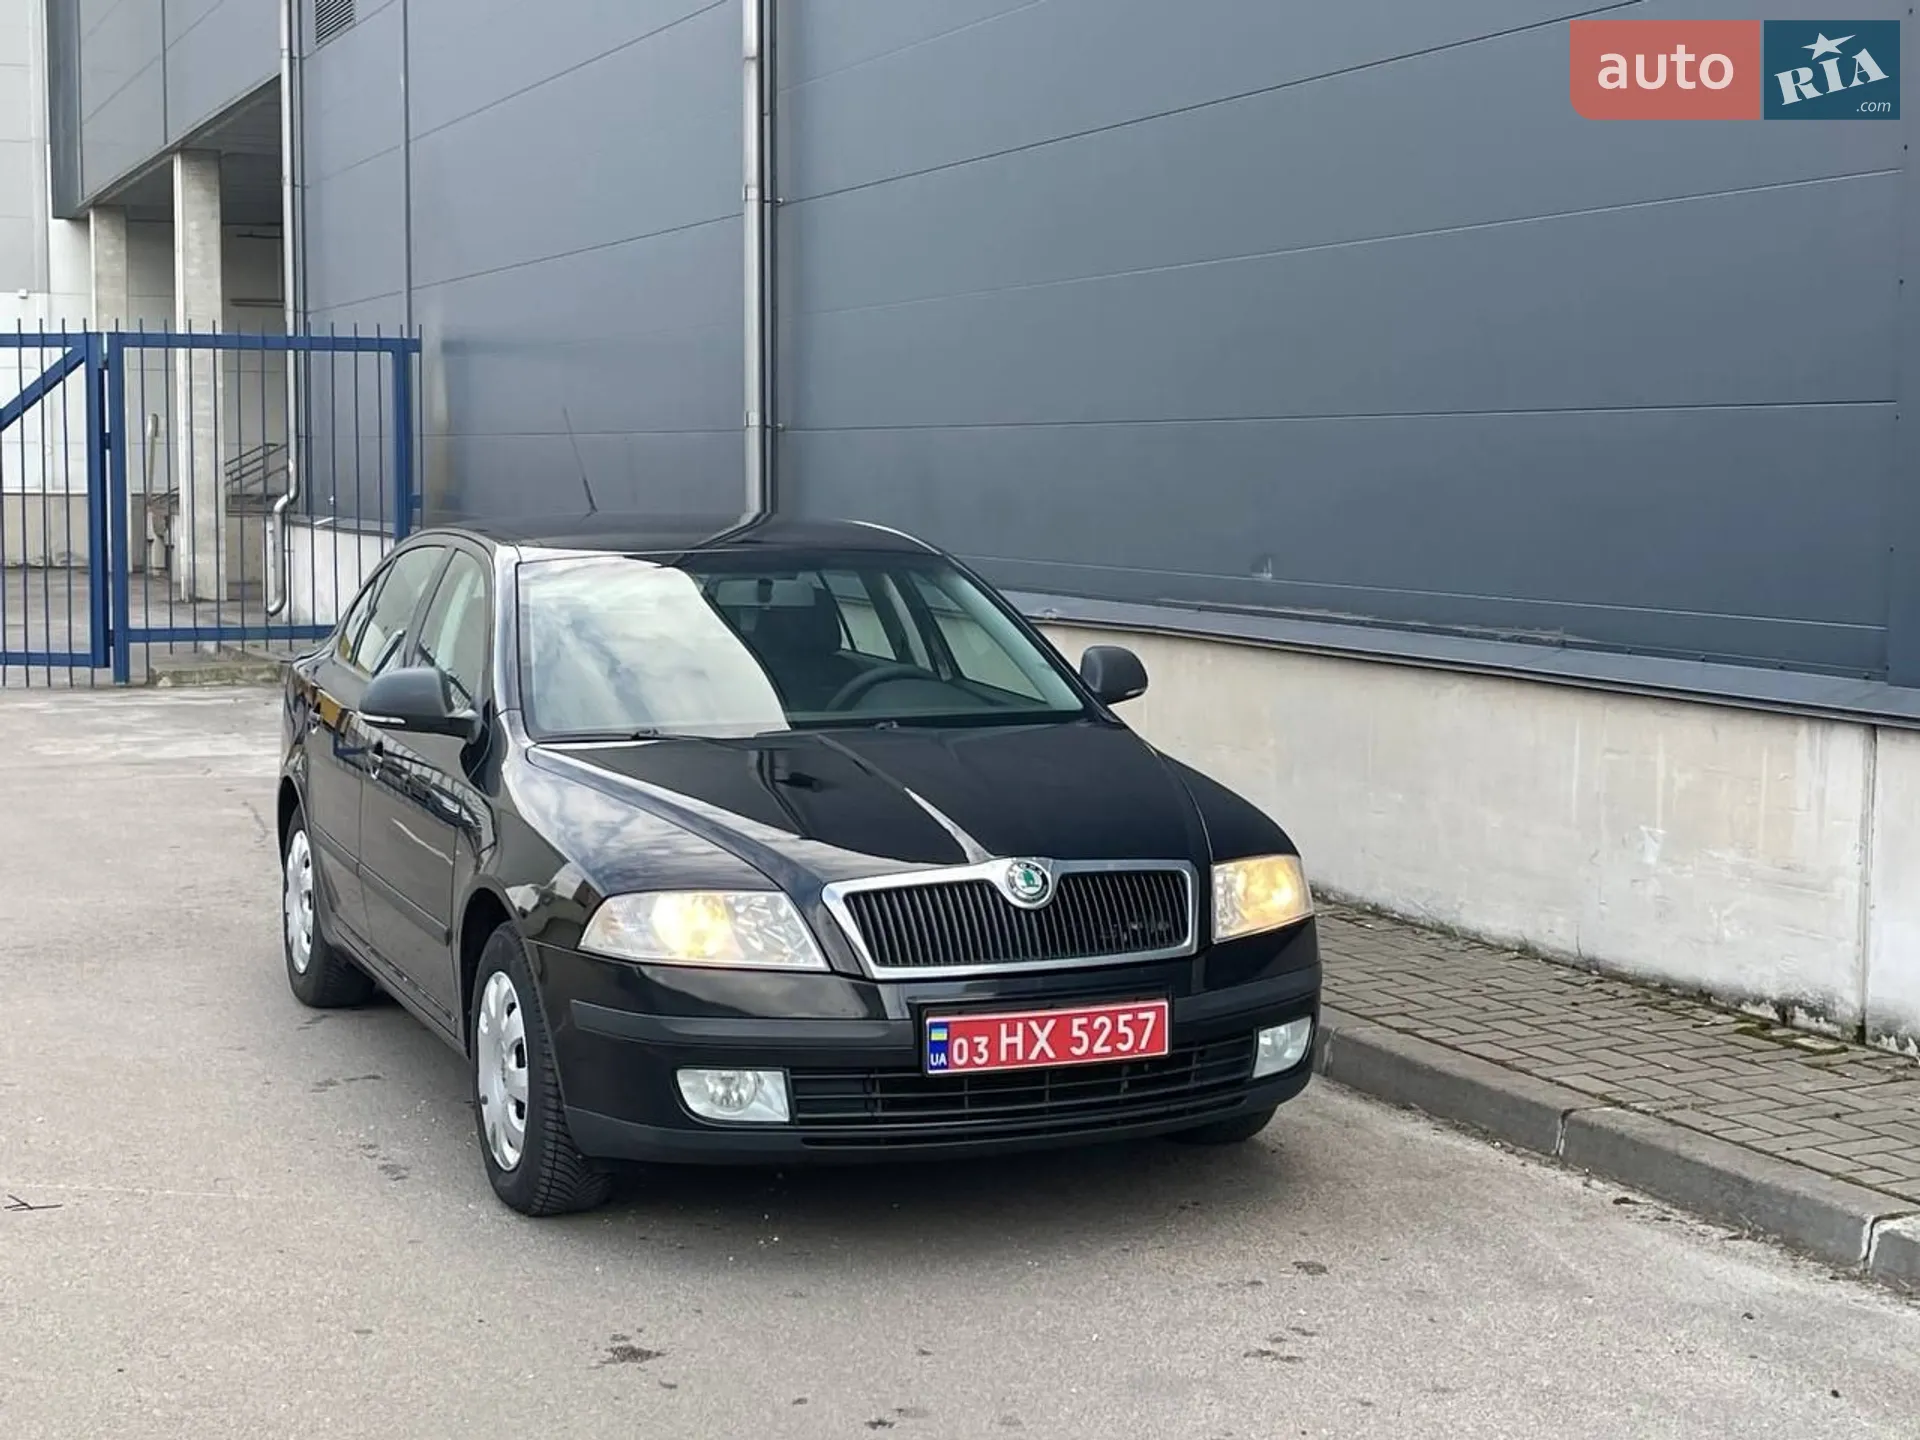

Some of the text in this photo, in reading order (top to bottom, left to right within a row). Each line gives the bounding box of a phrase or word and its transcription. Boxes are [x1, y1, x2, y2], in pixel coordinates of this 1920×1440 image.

[952, 1011, 1156, 1066] 03 HX 5257
[930, 1053, 947, 1066] UA
